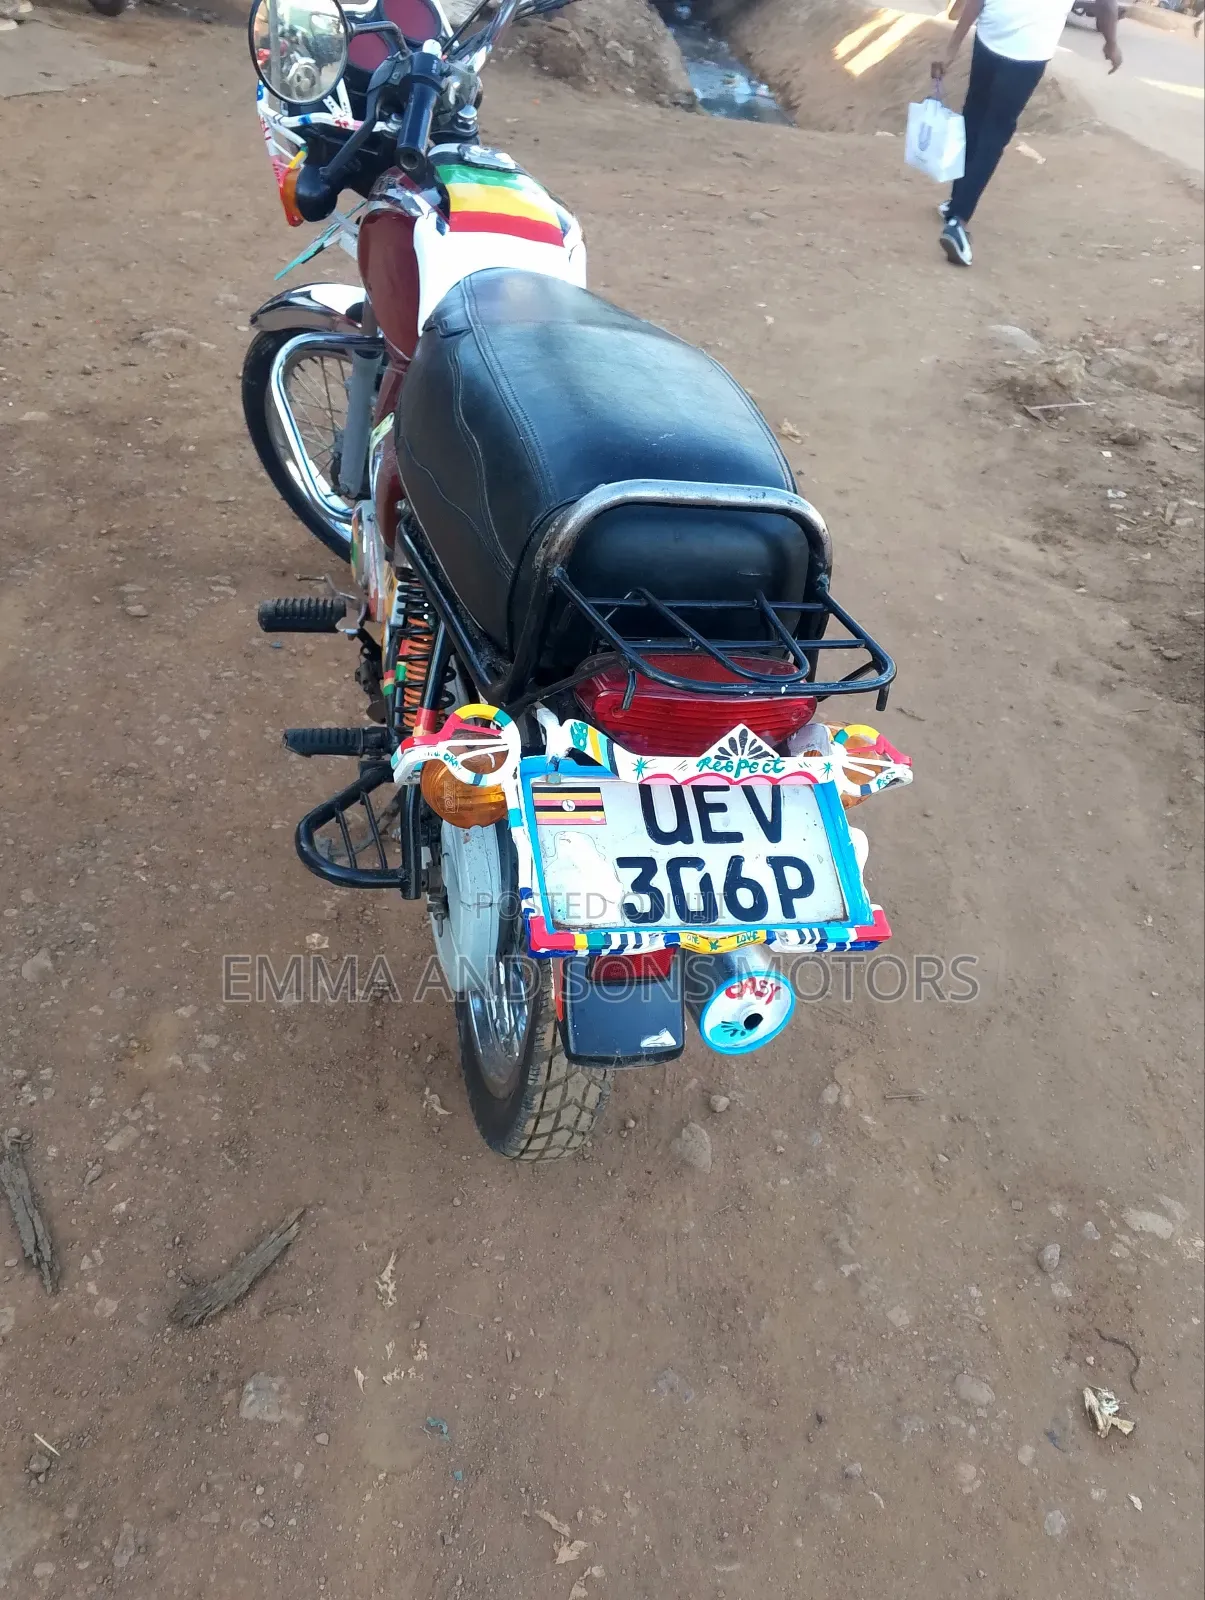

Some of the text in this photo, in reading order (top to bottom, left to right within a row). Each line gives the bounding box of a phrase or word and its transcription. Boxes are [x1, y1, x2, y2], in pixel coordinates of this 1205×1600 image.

[696, 756, 785, 778] Respect
[638, 785, 782, 846] UEV
[616, 855, 815, 924] 306P
[736, 930, 760, 944] LOVE
